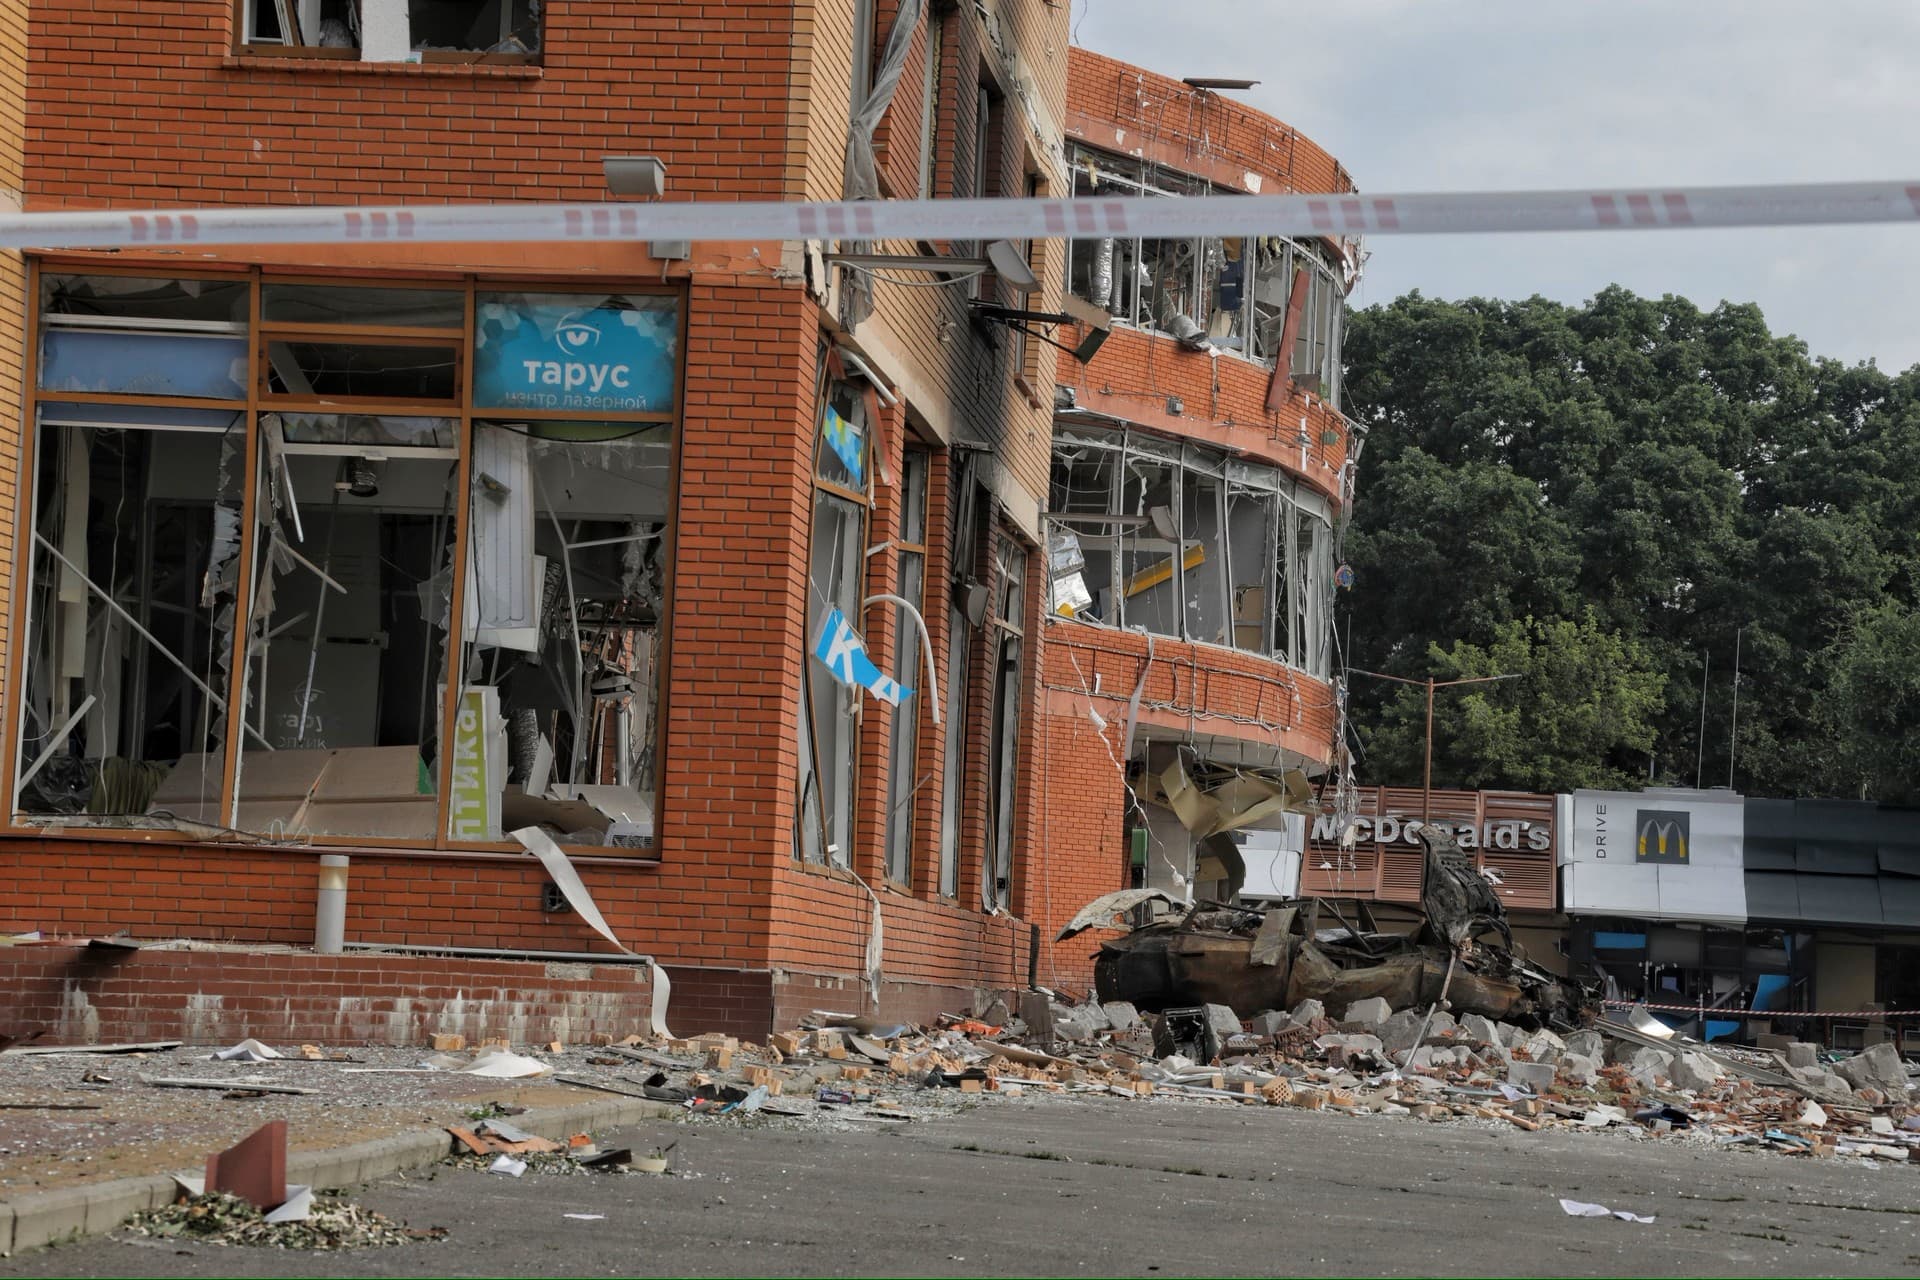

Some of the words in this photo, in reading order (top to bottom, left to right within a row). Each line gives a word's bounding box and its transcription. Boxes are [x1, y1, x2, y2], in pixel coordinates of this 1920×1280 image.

[523, 361, 630, 393] тарус
[562, 394, 648, 411] лазерной
[1311, 813, 1551, 850] McDoald's
[1596, 804, 1607, 859] DRIVE
